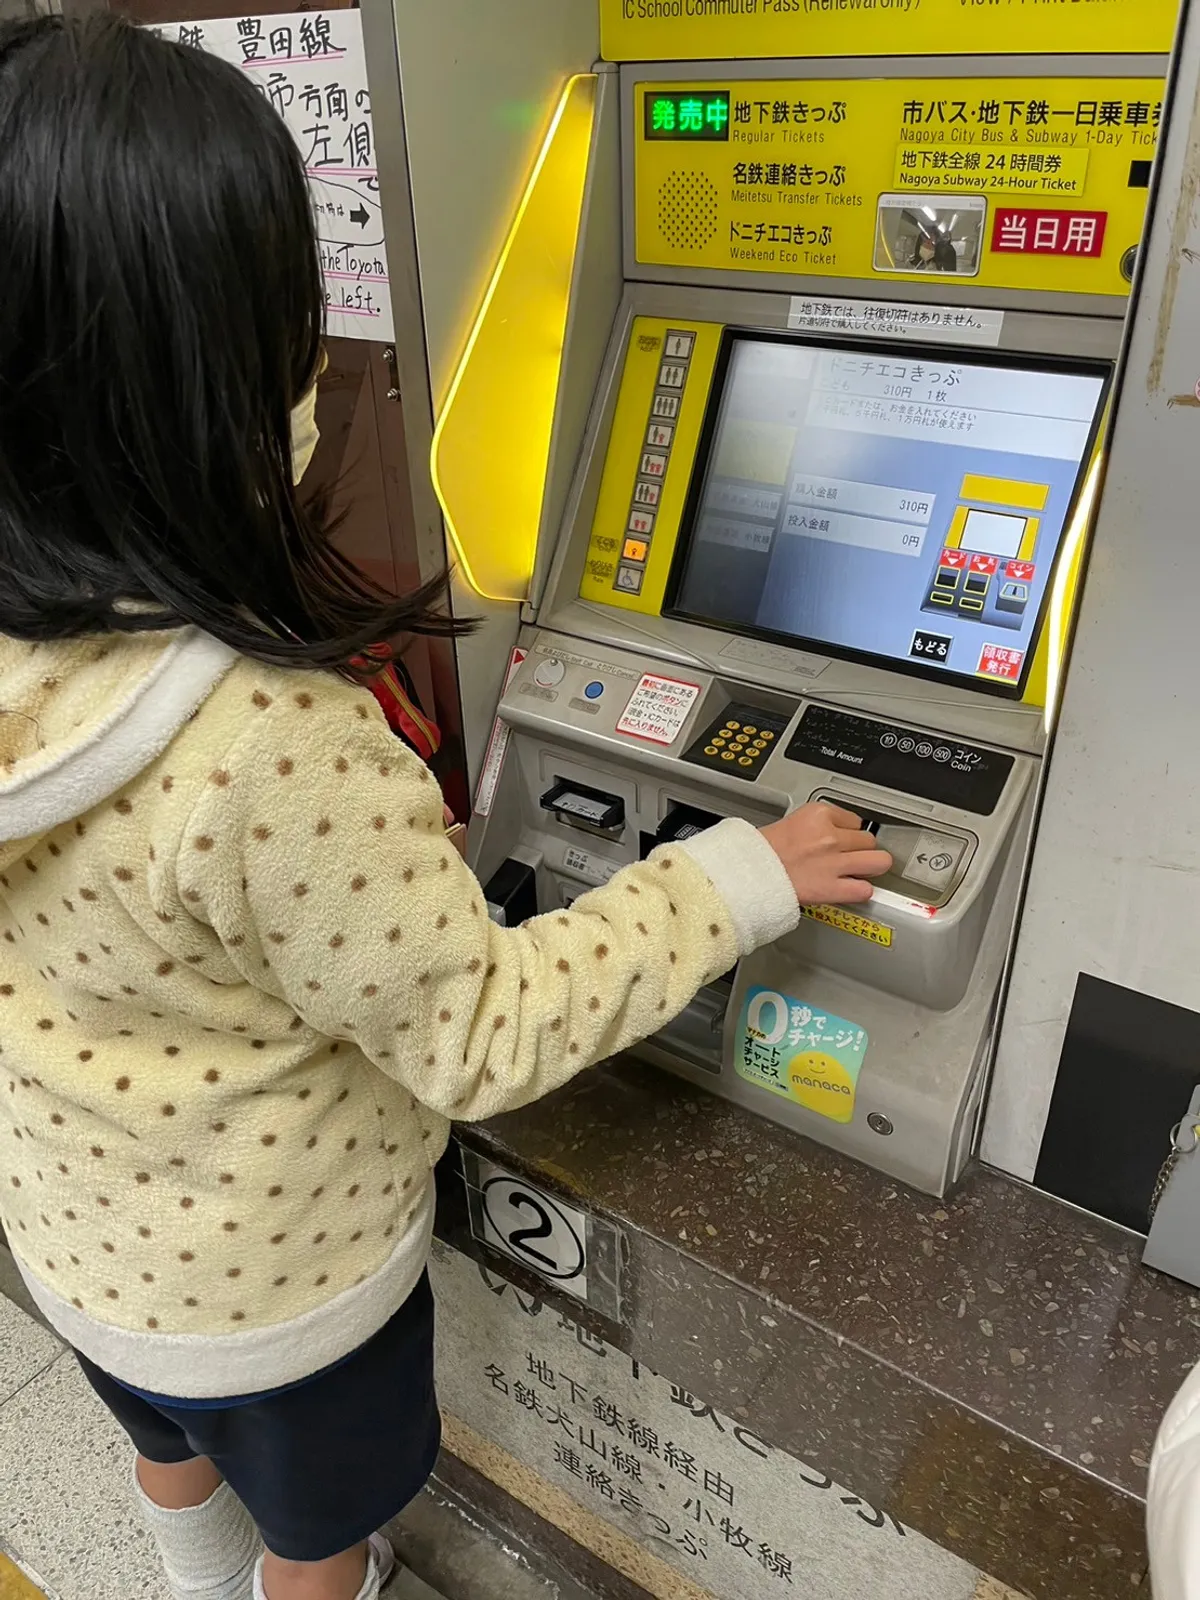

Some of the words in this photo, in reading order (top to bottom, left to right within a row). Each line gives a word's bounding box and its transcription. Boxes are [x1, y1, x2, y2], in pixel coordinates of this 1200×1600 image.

[623, 0, 635, 19] IC
[638, 0, 683, 18] School
[686, 0, 757, 16] Commuter
[236, 15, 347, 63] 豊田線
[254, 73, 371, 121] 市方面の
[652, 99, 728, 132] 発売中
[734, 100, 847, 125] 地下鉄きっぷ
[733, 130, 775, 145] Regular
[781, 131, 825, 144] Tickets
[900, 129, 944, 146] Nagoya
[950, 129, 975, 145] City
[981, 130, 1003, 143] Bus
[1010, 131, 1019, 143] &
[1026, 130, 1077, 147] Subway
[1086, 131, 1123, 147] 1-Day
[901, 151, 981, 172] 地下鉄全線
[985, 155, 1006, 170] 24
[1010, 154, 1062, 174] 時間券
[732, 162, 847, 188] 名鉄連絡きっぷ
[900, 173, 941, 188] Nagoya
[943, 174, 988, 190] Subway
[990, 175, 1037, 189] 24-Hour
[1041, 178, 1076, 191] Ticket
[731, 190, 773, 204] Meitetsu
[778, 192, 819, 205] Transfer
[825, 193, 863, 207] Tickets
[729, 221, 832, 248] ドニチエコきっぷ
[999, 214, 1097, 253] 当日用
[320, 246, 340, 271] the
[337, 244, 386, 281] Toyota
[730, 247, 775, 262] Weekend
[779, 250, 798, 263] Eco
[803, 252, 837, 266] Ticket
[341, 285, 381, 314] left.
[800, 302, 983, 330] 地下鉄では、往復切符はありません。
[831, 356, 962, 387] ドニチエコきっぷ
[883, 385, 912, 398] 310円
[899, 499, 929, 514] 310円
[787, 514, 830, 533] 投入金額
[902, 534, 920, 548] 0円
[943, 551, 966, 562] カード
[1009, 563, 1034, 574] コイン
[914, 638, 947, 656] もどる
[984, 646, 1021, 665] 領収書
[986, 661, 1011, 676] 発行
[821, 745, 837, 757] Total
[837, 751, 864, 765] Amount
[918, 745, 930, 755] 100
[935, 750, 948, 760] 500
[954, 750, 982, 765] コイン
[950, 760, 972, 773] Coin
[744, 1036, 781, 1058] オート
[744, 1046, 780, 1067] チャージ
[743, 1056, 780, 1079] サービス
[792, 1074, 851, 1096] manaca
[508, 1191, 557, 1270] 2
[526, 1351, 735, 1507] 地下鉄線経由
[484, 1362, 794, 1585] 名鉄犬山線・小牧線
[552, 1441, 708, 1562] 連絡きっぷ
